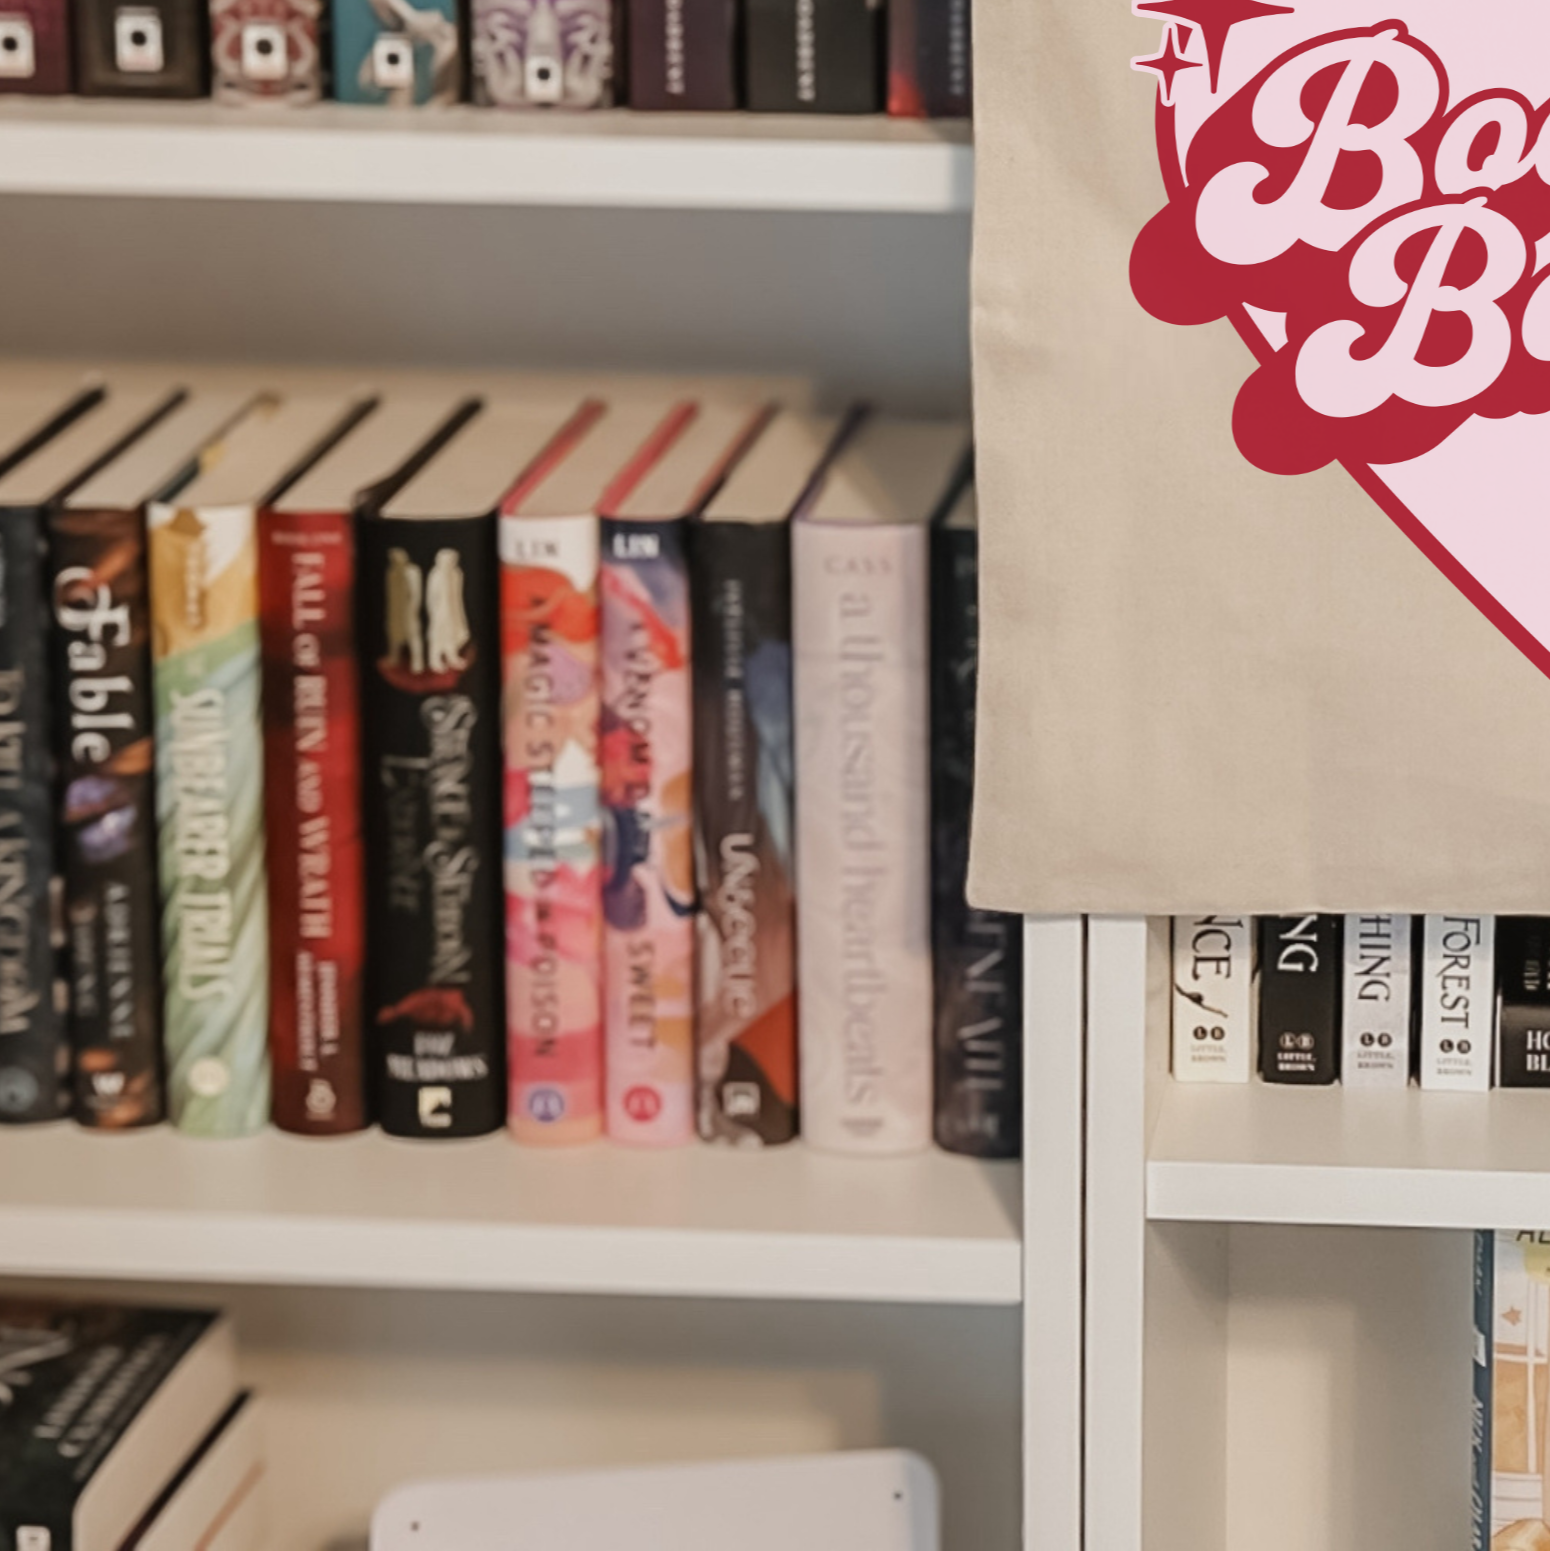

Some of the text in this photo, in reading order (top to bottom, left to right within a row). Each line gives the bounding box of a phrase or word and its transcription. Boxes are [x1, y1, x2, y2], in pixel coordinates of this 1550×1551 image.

[291, 552, 326, 631] FALL
[612, 532, 660, 560] LIN
[823, 554, 894, 577] CASS
[53, 564, 135, 764] Fable
[293, 675, 328, 753] RUIN
[523, 621, 556, 730] MAGIC
[297, 814, 332, 939] WRATH
[626, 941, 658, 1050] SWEET
[1435, 916, 1481, 1029] FOREST
